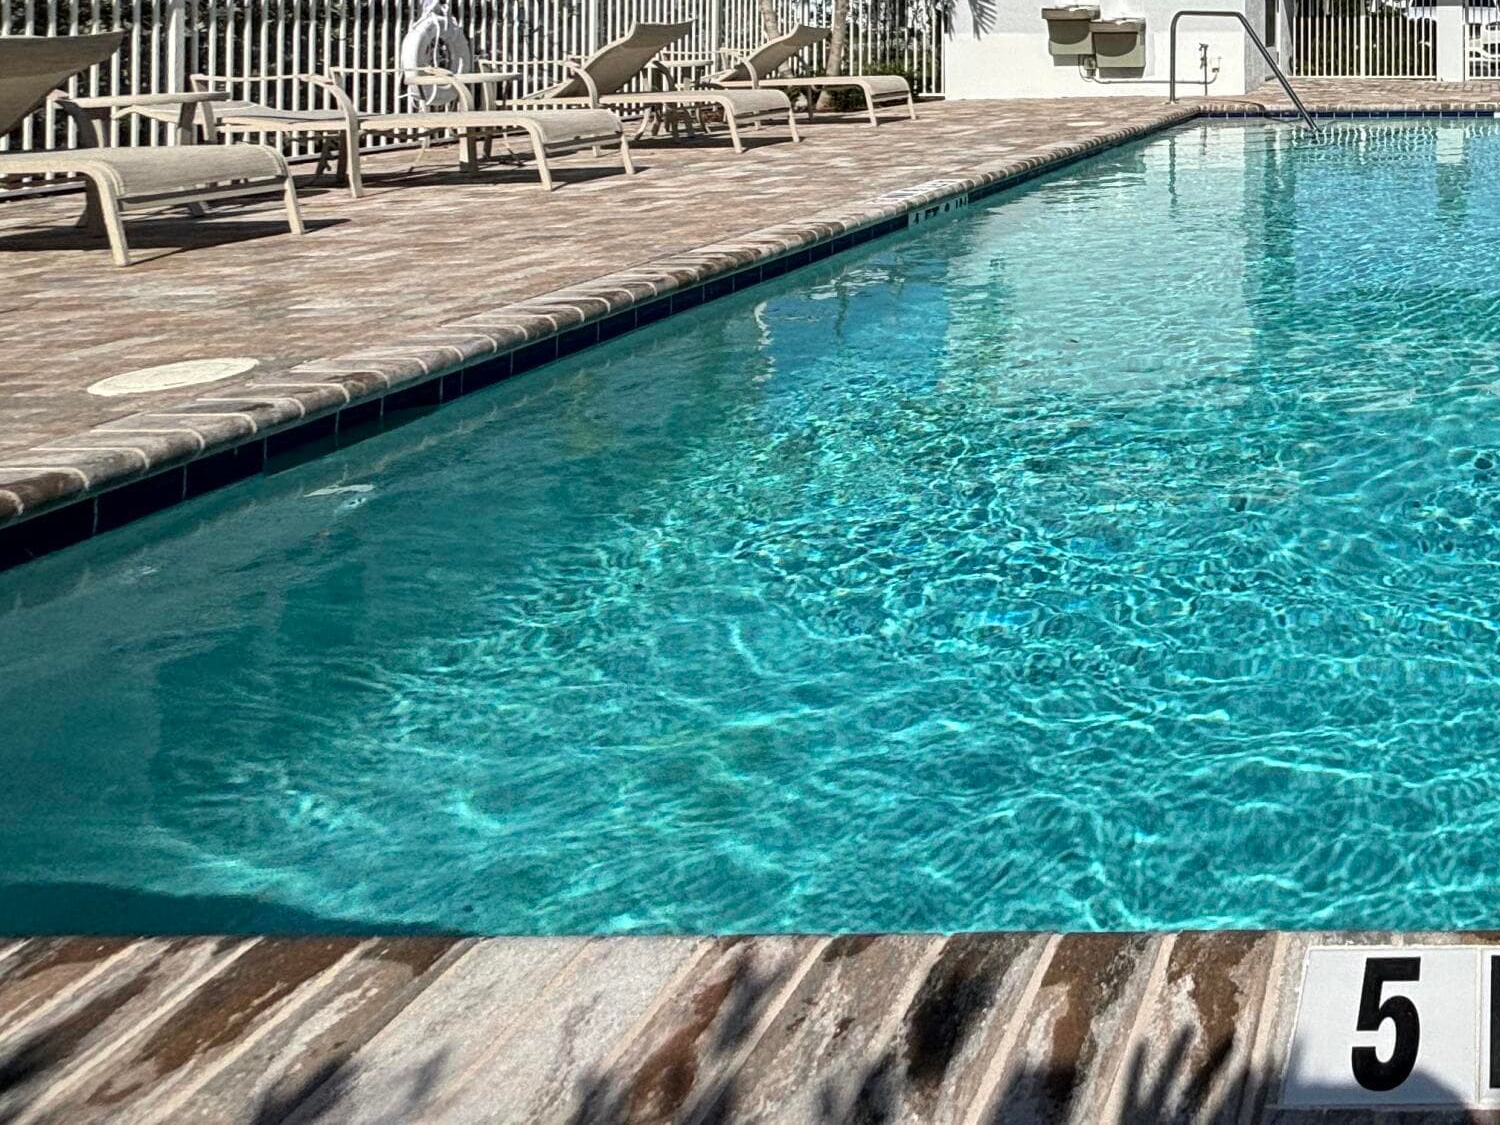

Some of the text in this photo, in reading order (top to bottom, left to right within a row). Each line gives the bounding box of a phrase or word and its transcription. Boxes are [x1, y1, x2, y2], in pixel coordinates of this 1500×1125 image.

[925, 206, 940, 220] FT
[955, 196, 967, 209] IN
[1351, 956, 1421, 1091] 5
